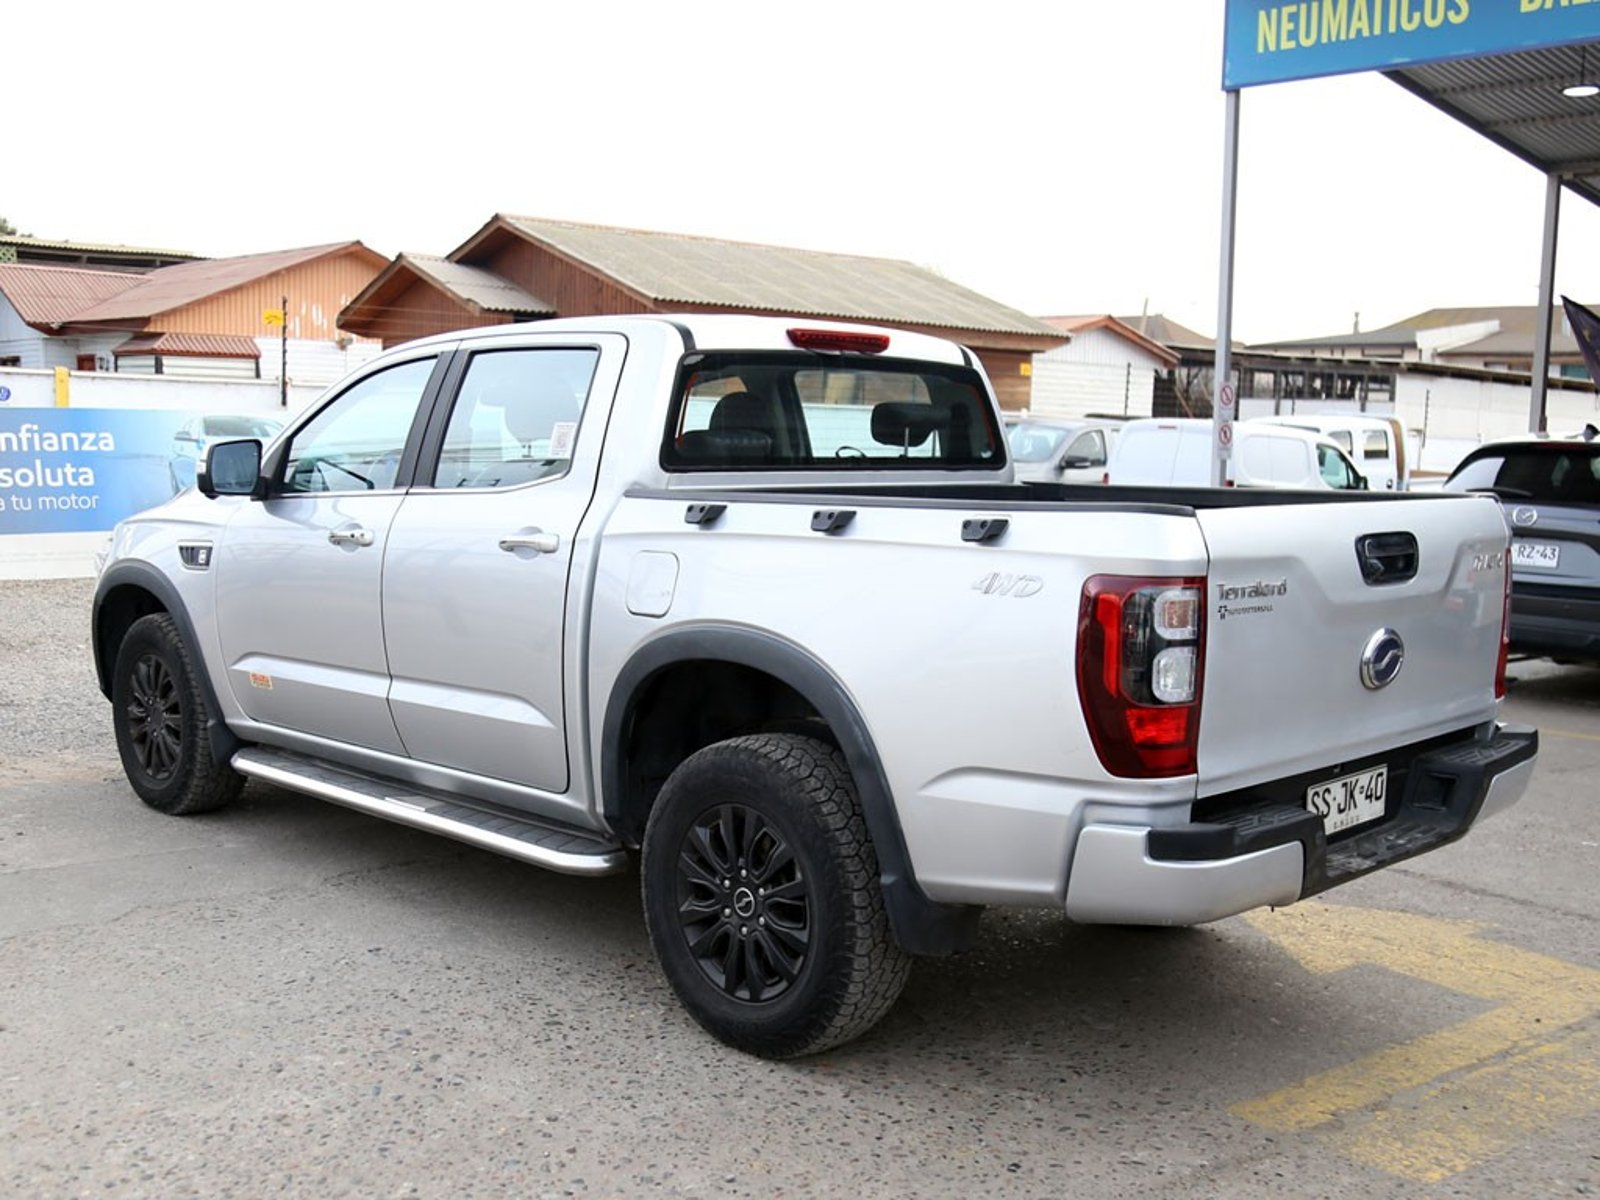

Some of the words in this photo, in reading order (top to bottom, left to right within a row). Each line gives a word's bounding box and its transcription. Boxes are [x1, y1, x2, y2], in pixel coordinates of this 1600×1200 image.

[0, 423, 115, 452] nfianza
[0, 459, 95, 488] soluta
[11, 494, 32, 511] tu
[38, 493, 99, 510] motor
